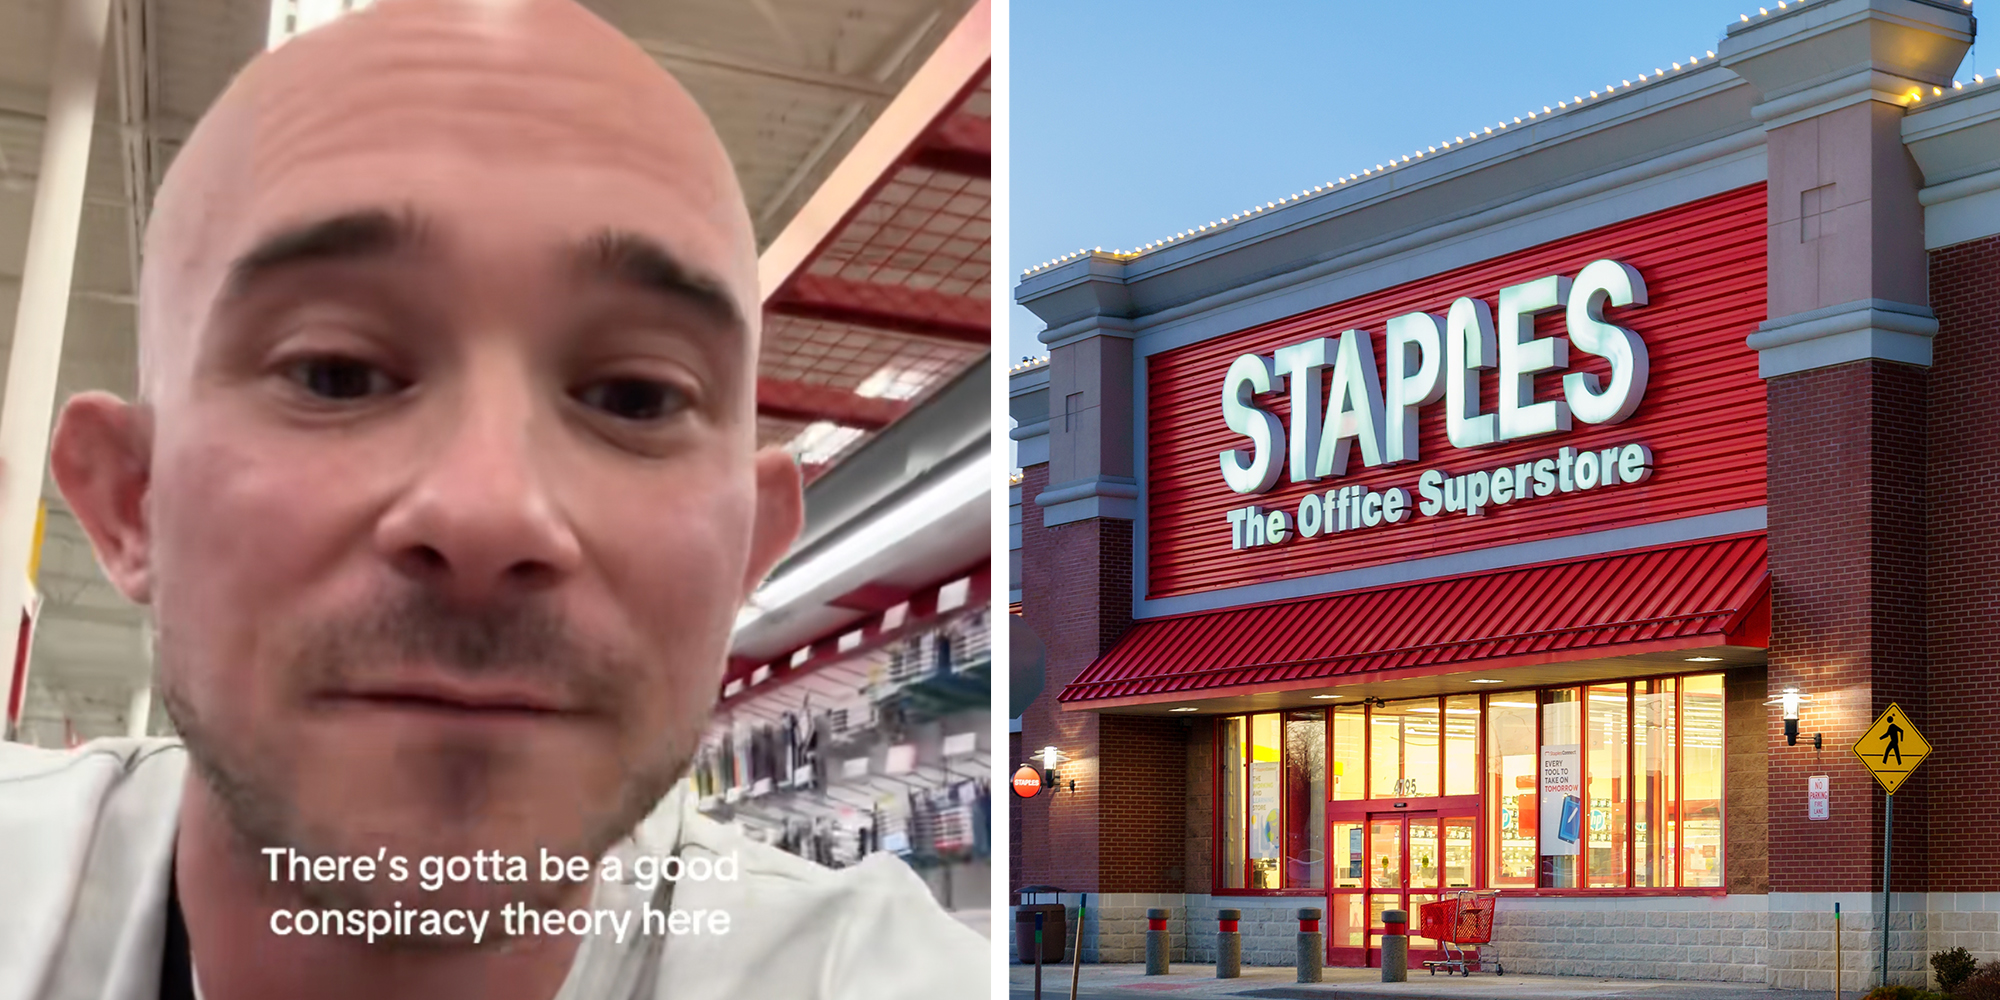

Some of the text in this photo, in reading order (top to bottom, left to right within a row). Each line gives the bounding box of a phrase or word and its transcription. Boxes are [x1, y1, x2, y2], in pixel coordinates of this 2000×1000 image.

[1219, 259, 1649, 494] STAPLES
[1227, 443, 1653, 549] The Office Superstore
[1394, 779, 1416, 795] 4795
[1810, 791, 1827, 799] PARKING
